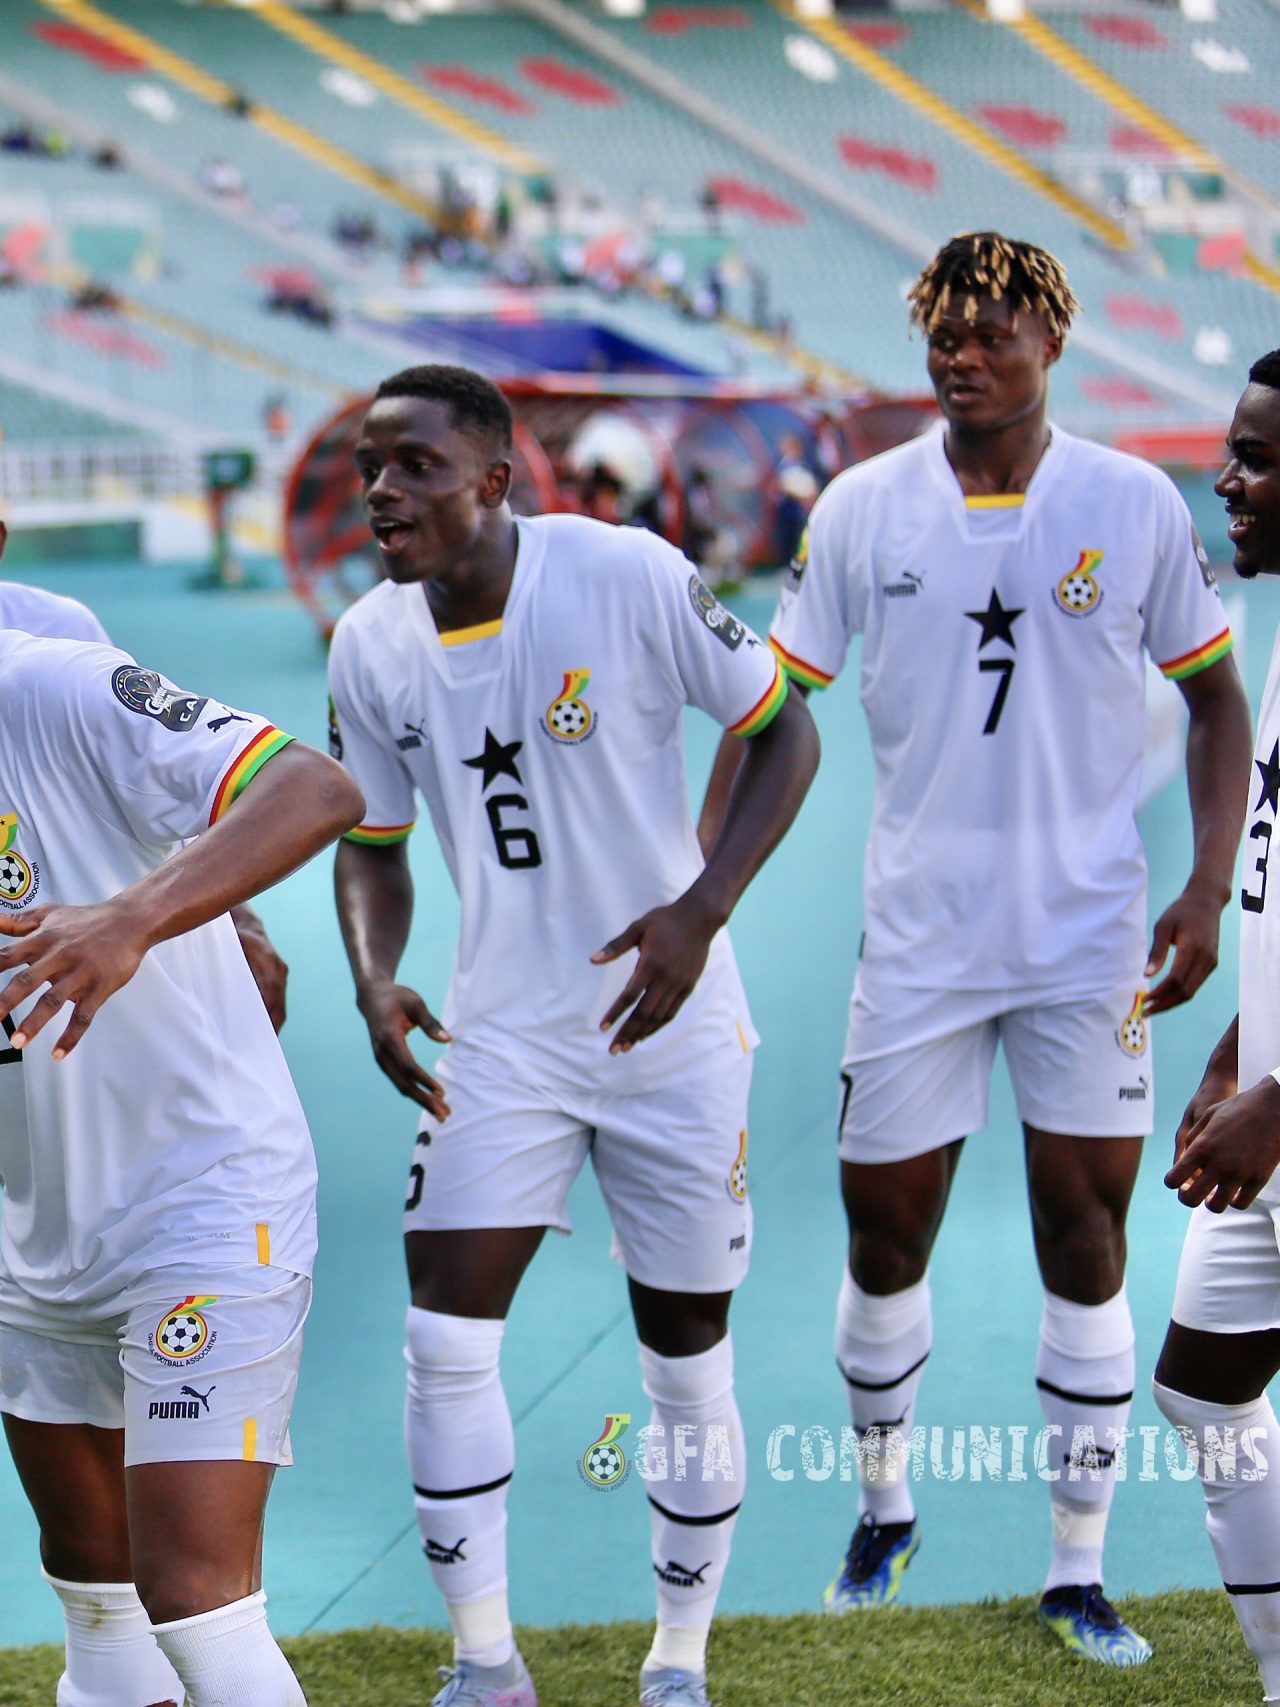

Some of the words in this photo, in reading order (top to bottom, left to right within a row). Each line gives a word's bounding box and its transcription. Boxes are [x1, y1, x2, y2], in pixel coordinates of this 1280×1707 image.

[979, 659, 1015, 736] 7
[486, 793, 542, 870] 6
[23, 862, 40, 906] ASSOCIATION
[1241, 820, 1272, 914] 3
[154, 1352, 185, 1368] FOOTBALL
[186, 1331, 218, 1366] ASSOCIATION
[148, 1401, 200, 1419] PUMA
